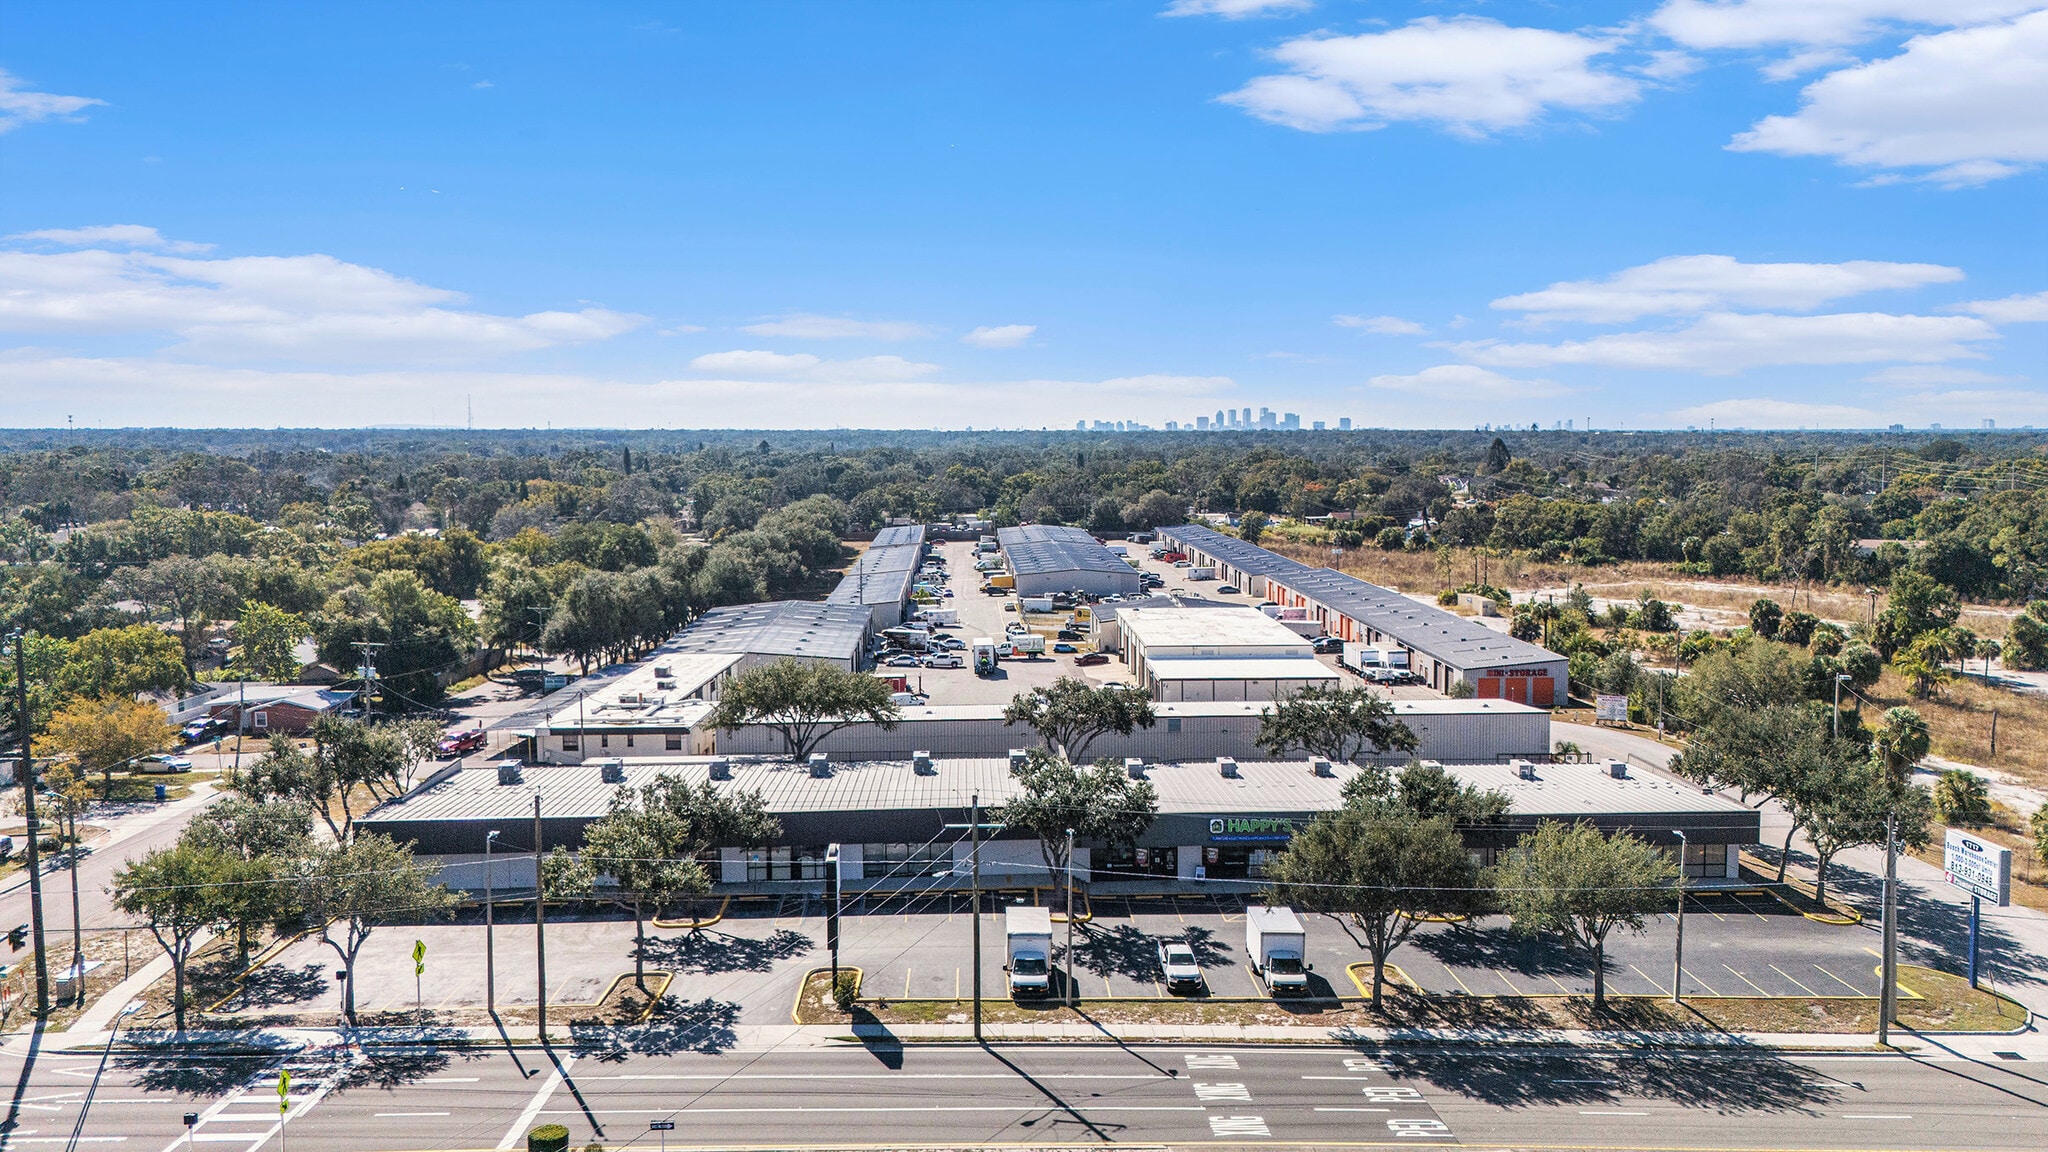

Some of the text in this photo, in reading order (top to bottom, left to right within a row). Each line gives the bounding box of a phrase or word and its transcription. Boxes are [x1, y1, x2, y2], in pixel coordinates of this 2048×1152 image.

[1227, 818, 1292, 832] HAPPY'S
[1961, 847, 1984, 862] Warehouse
[1974, 885, 1998, 902] STORAGE
[1193, 1083, 1252, 1101] XING
[1362, 1087, 1427, 1103] PED
[1208, 1115, 1271, 1137] XING
[1386, 1119, 1454, 1137] PED
